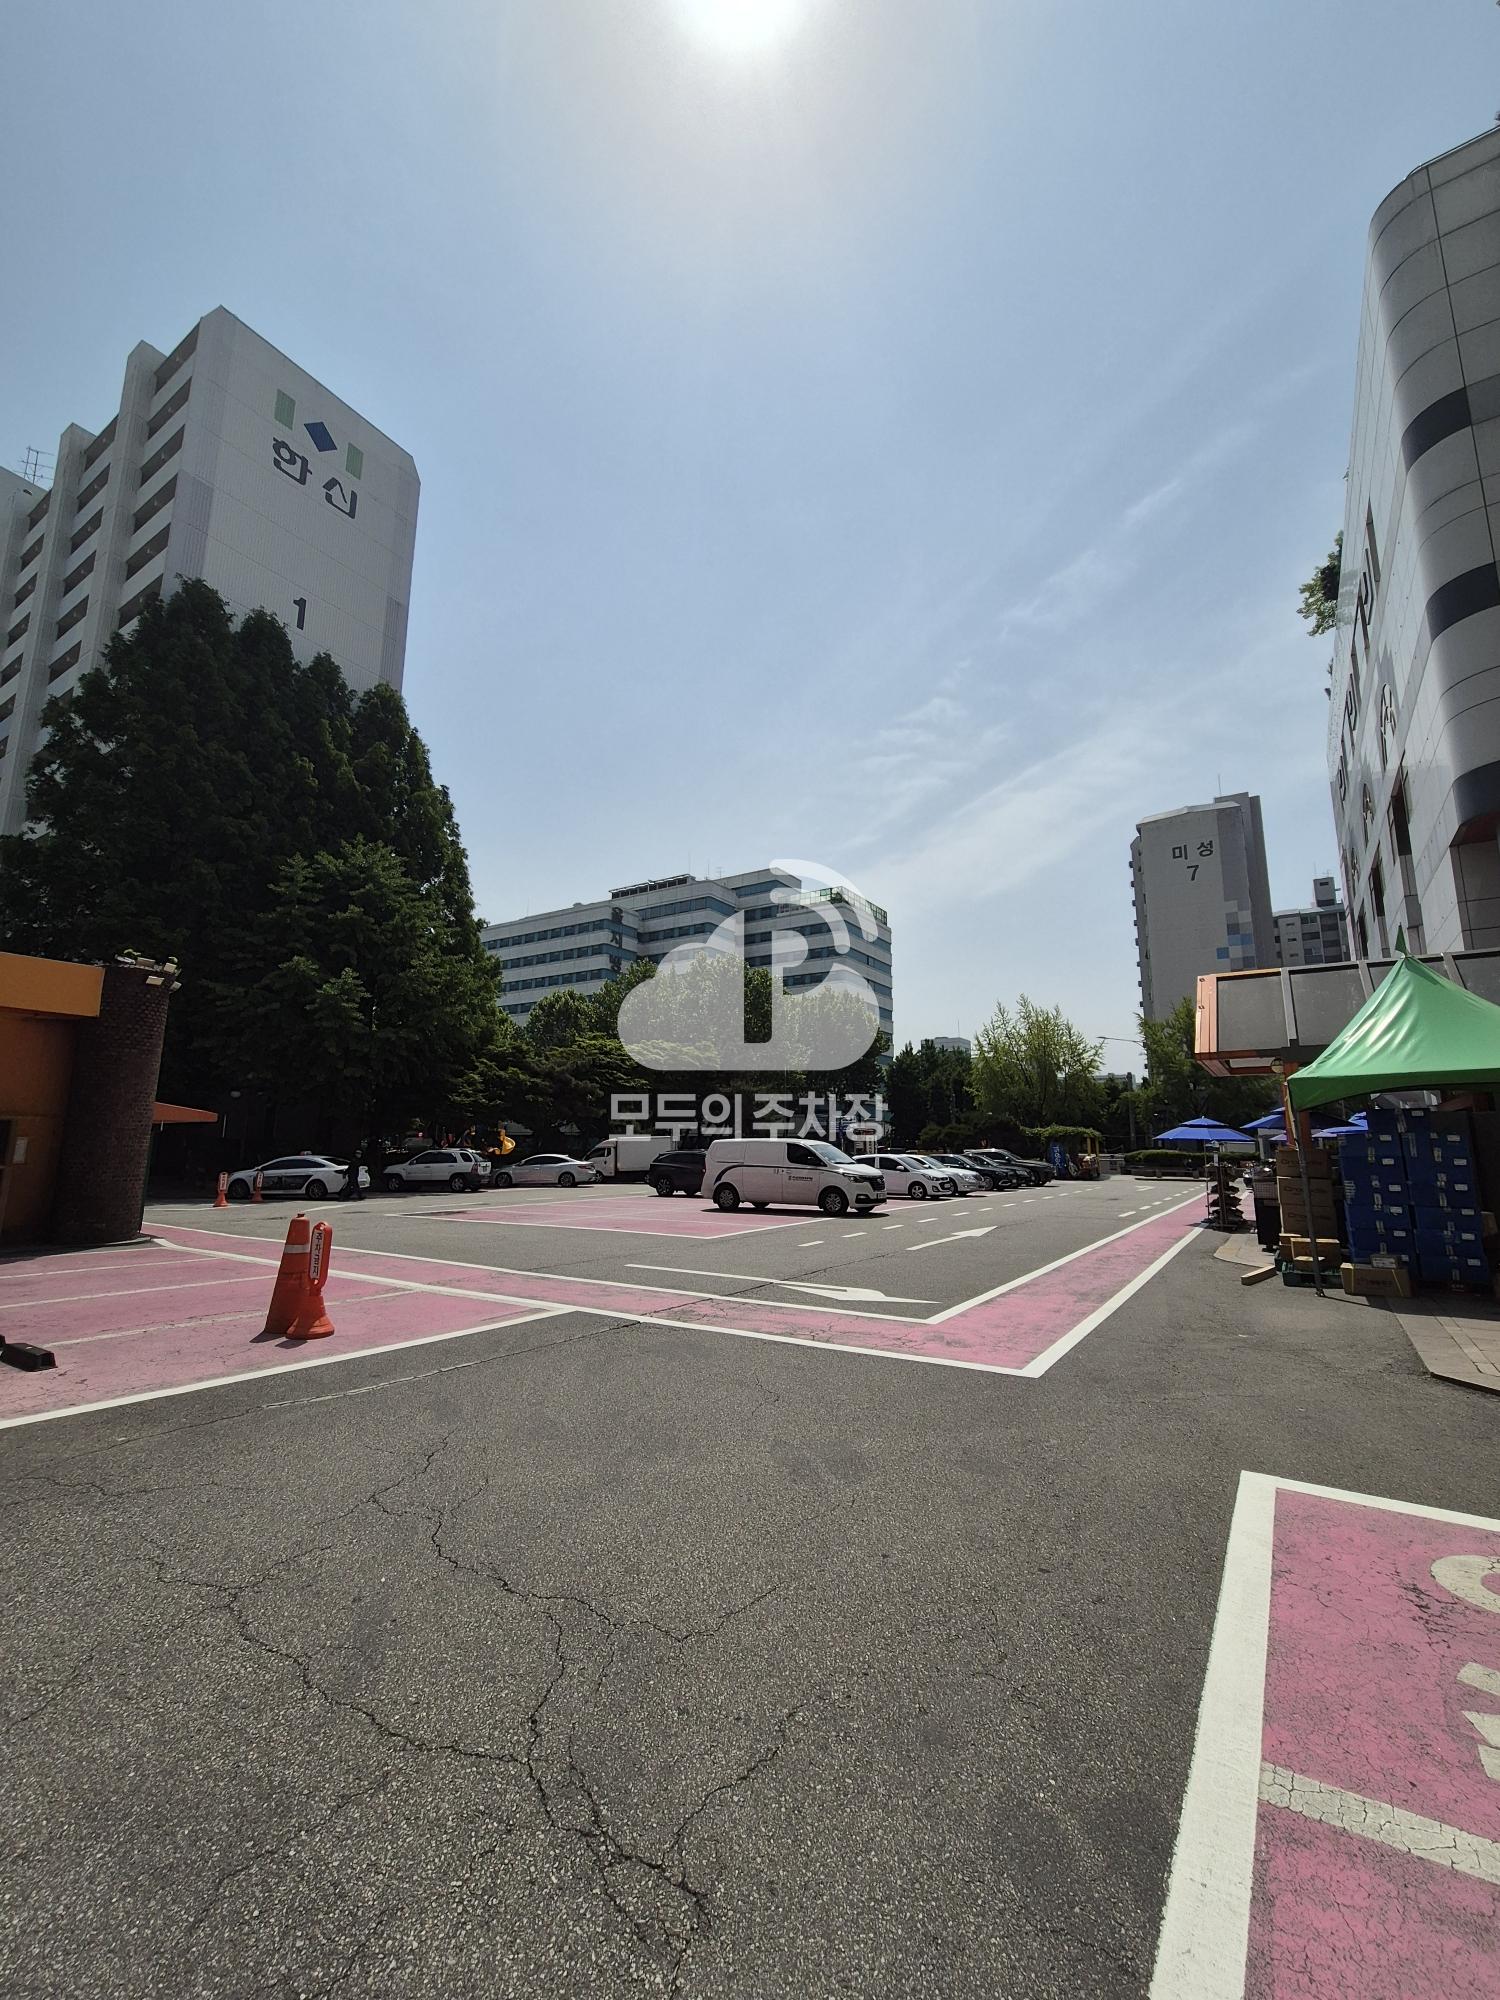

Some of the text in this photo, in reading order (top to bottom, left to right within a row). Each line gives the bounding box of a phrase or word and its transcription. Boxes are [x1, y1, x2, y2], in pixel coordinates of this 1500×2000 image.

[272, 436, 358, 519] 한신
[292, 596, 308, 632] 1
[1171, 839, 1215, 861] 미성
[1186, 864, 1200, 882] 7
